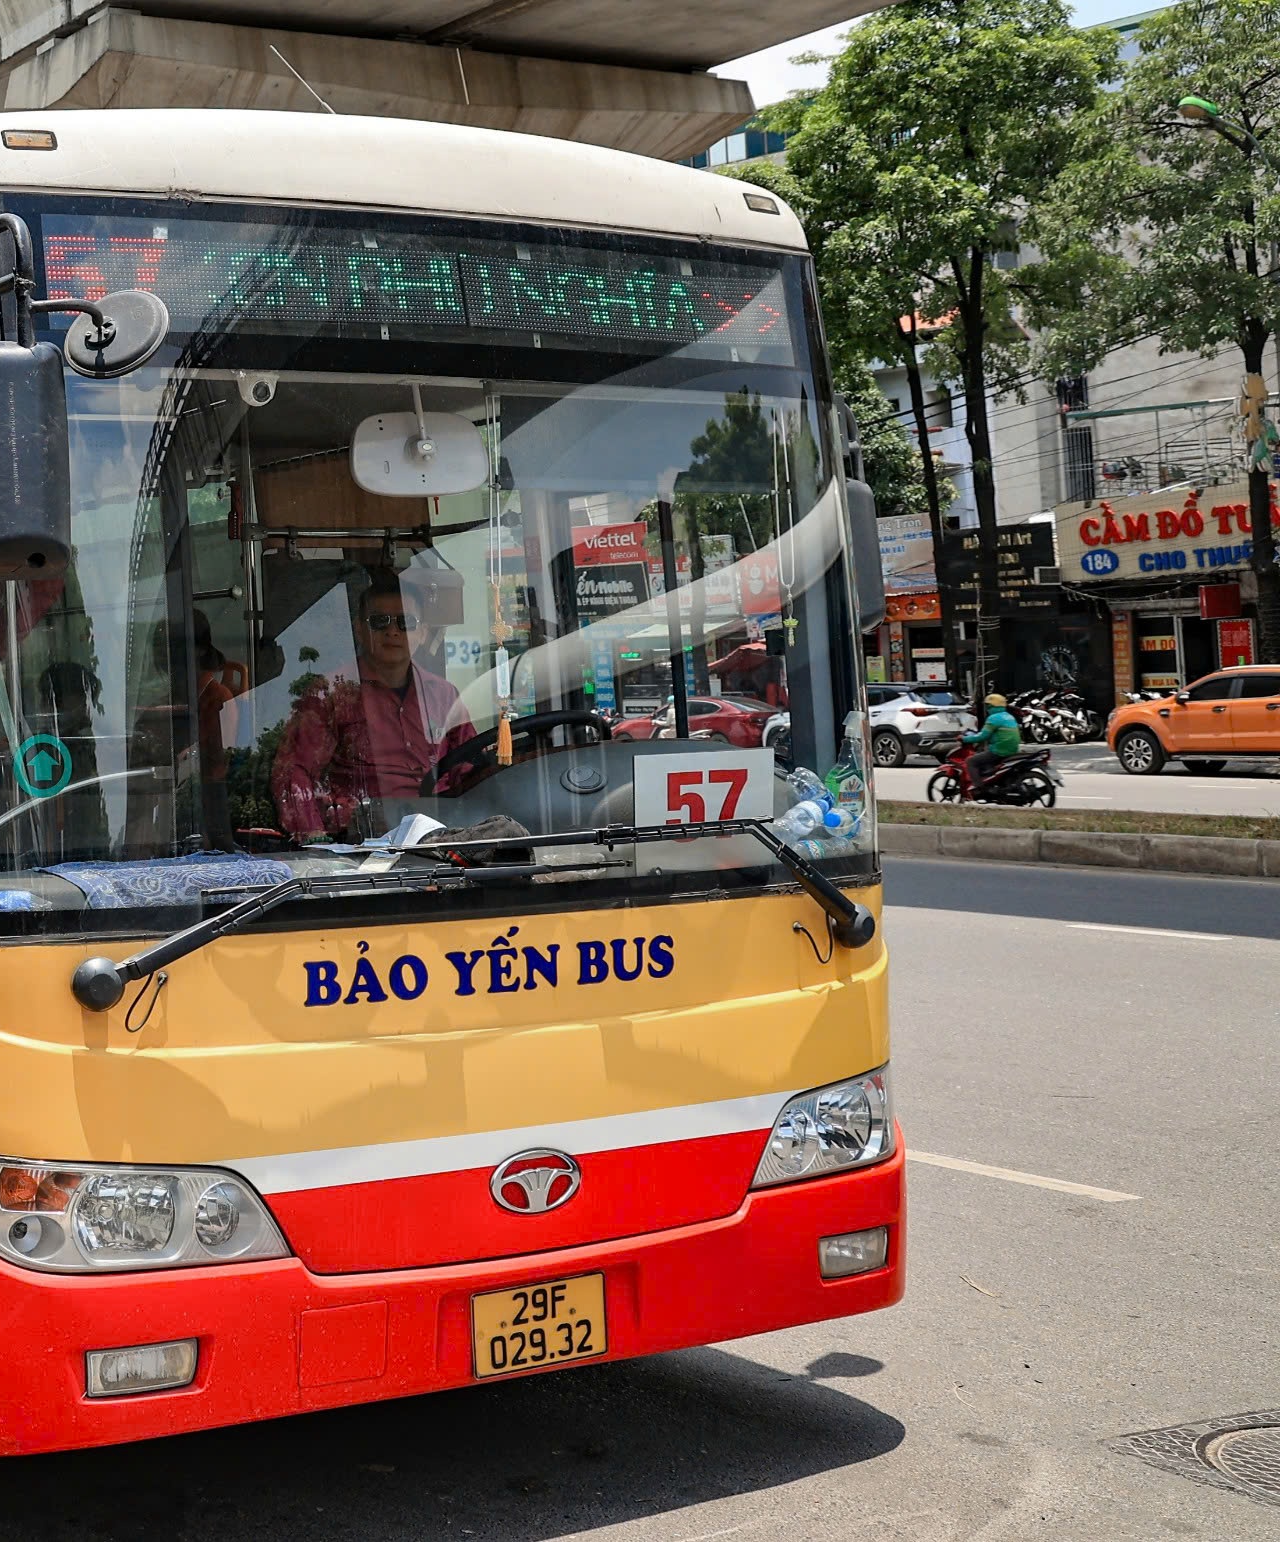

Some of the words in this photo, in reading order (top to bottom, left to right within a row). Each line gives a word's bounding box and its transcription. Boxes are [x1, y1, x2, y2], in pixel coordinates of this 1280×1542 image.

[584, 531, 637, 549] viettel
[1079, 501, 1152, 546] CẦM
[1156, 489, 1205, 540] ĐỒ
[1085, 551, 1113, 571] 184
[1138, 550, 1187, 573] CHO
[666, 769, 748, 825] 57
[303, 940, 428, 1007] BẢO
[445, 925, 561, 997] YẾN
[577, 935, 674, 985] BUS
[512, 1284, 567, 1326] 29F
[490, 1319, 593, 1369] 029.32
